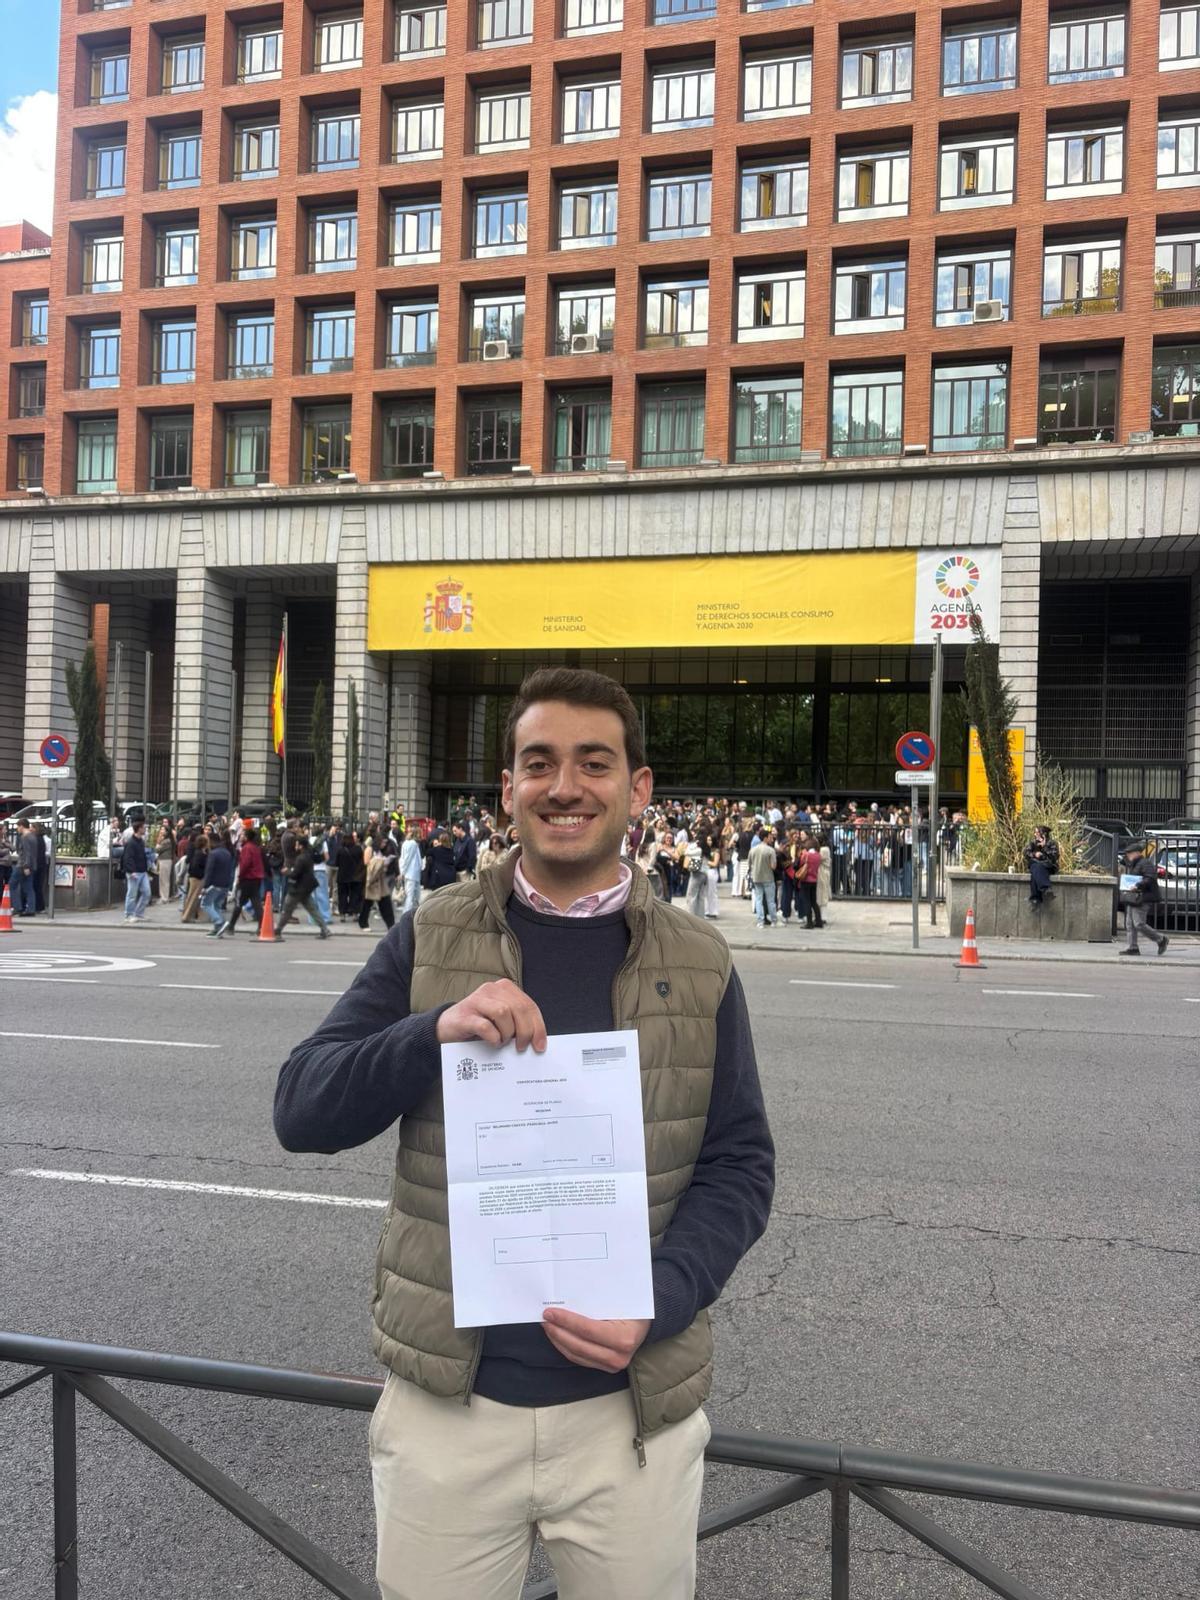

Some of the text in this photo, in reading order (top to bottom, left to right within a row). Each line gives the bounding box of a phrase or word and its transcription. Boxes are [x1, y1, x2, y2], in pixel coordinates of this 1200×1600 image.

[697, 603, 740, 611] MINISTERIO
[931, 603, 982, 613] AGENDA
[543, 615, 583, 623] MINISTERIO
[697, 612, 706, 620] DE
[708, 611, 750, 620] DERECHOS
[791, 610, 834, 618] CONSUMO
[703, 621, 735, 630] AGENDA
[736, 621, 753, 629] 2030
